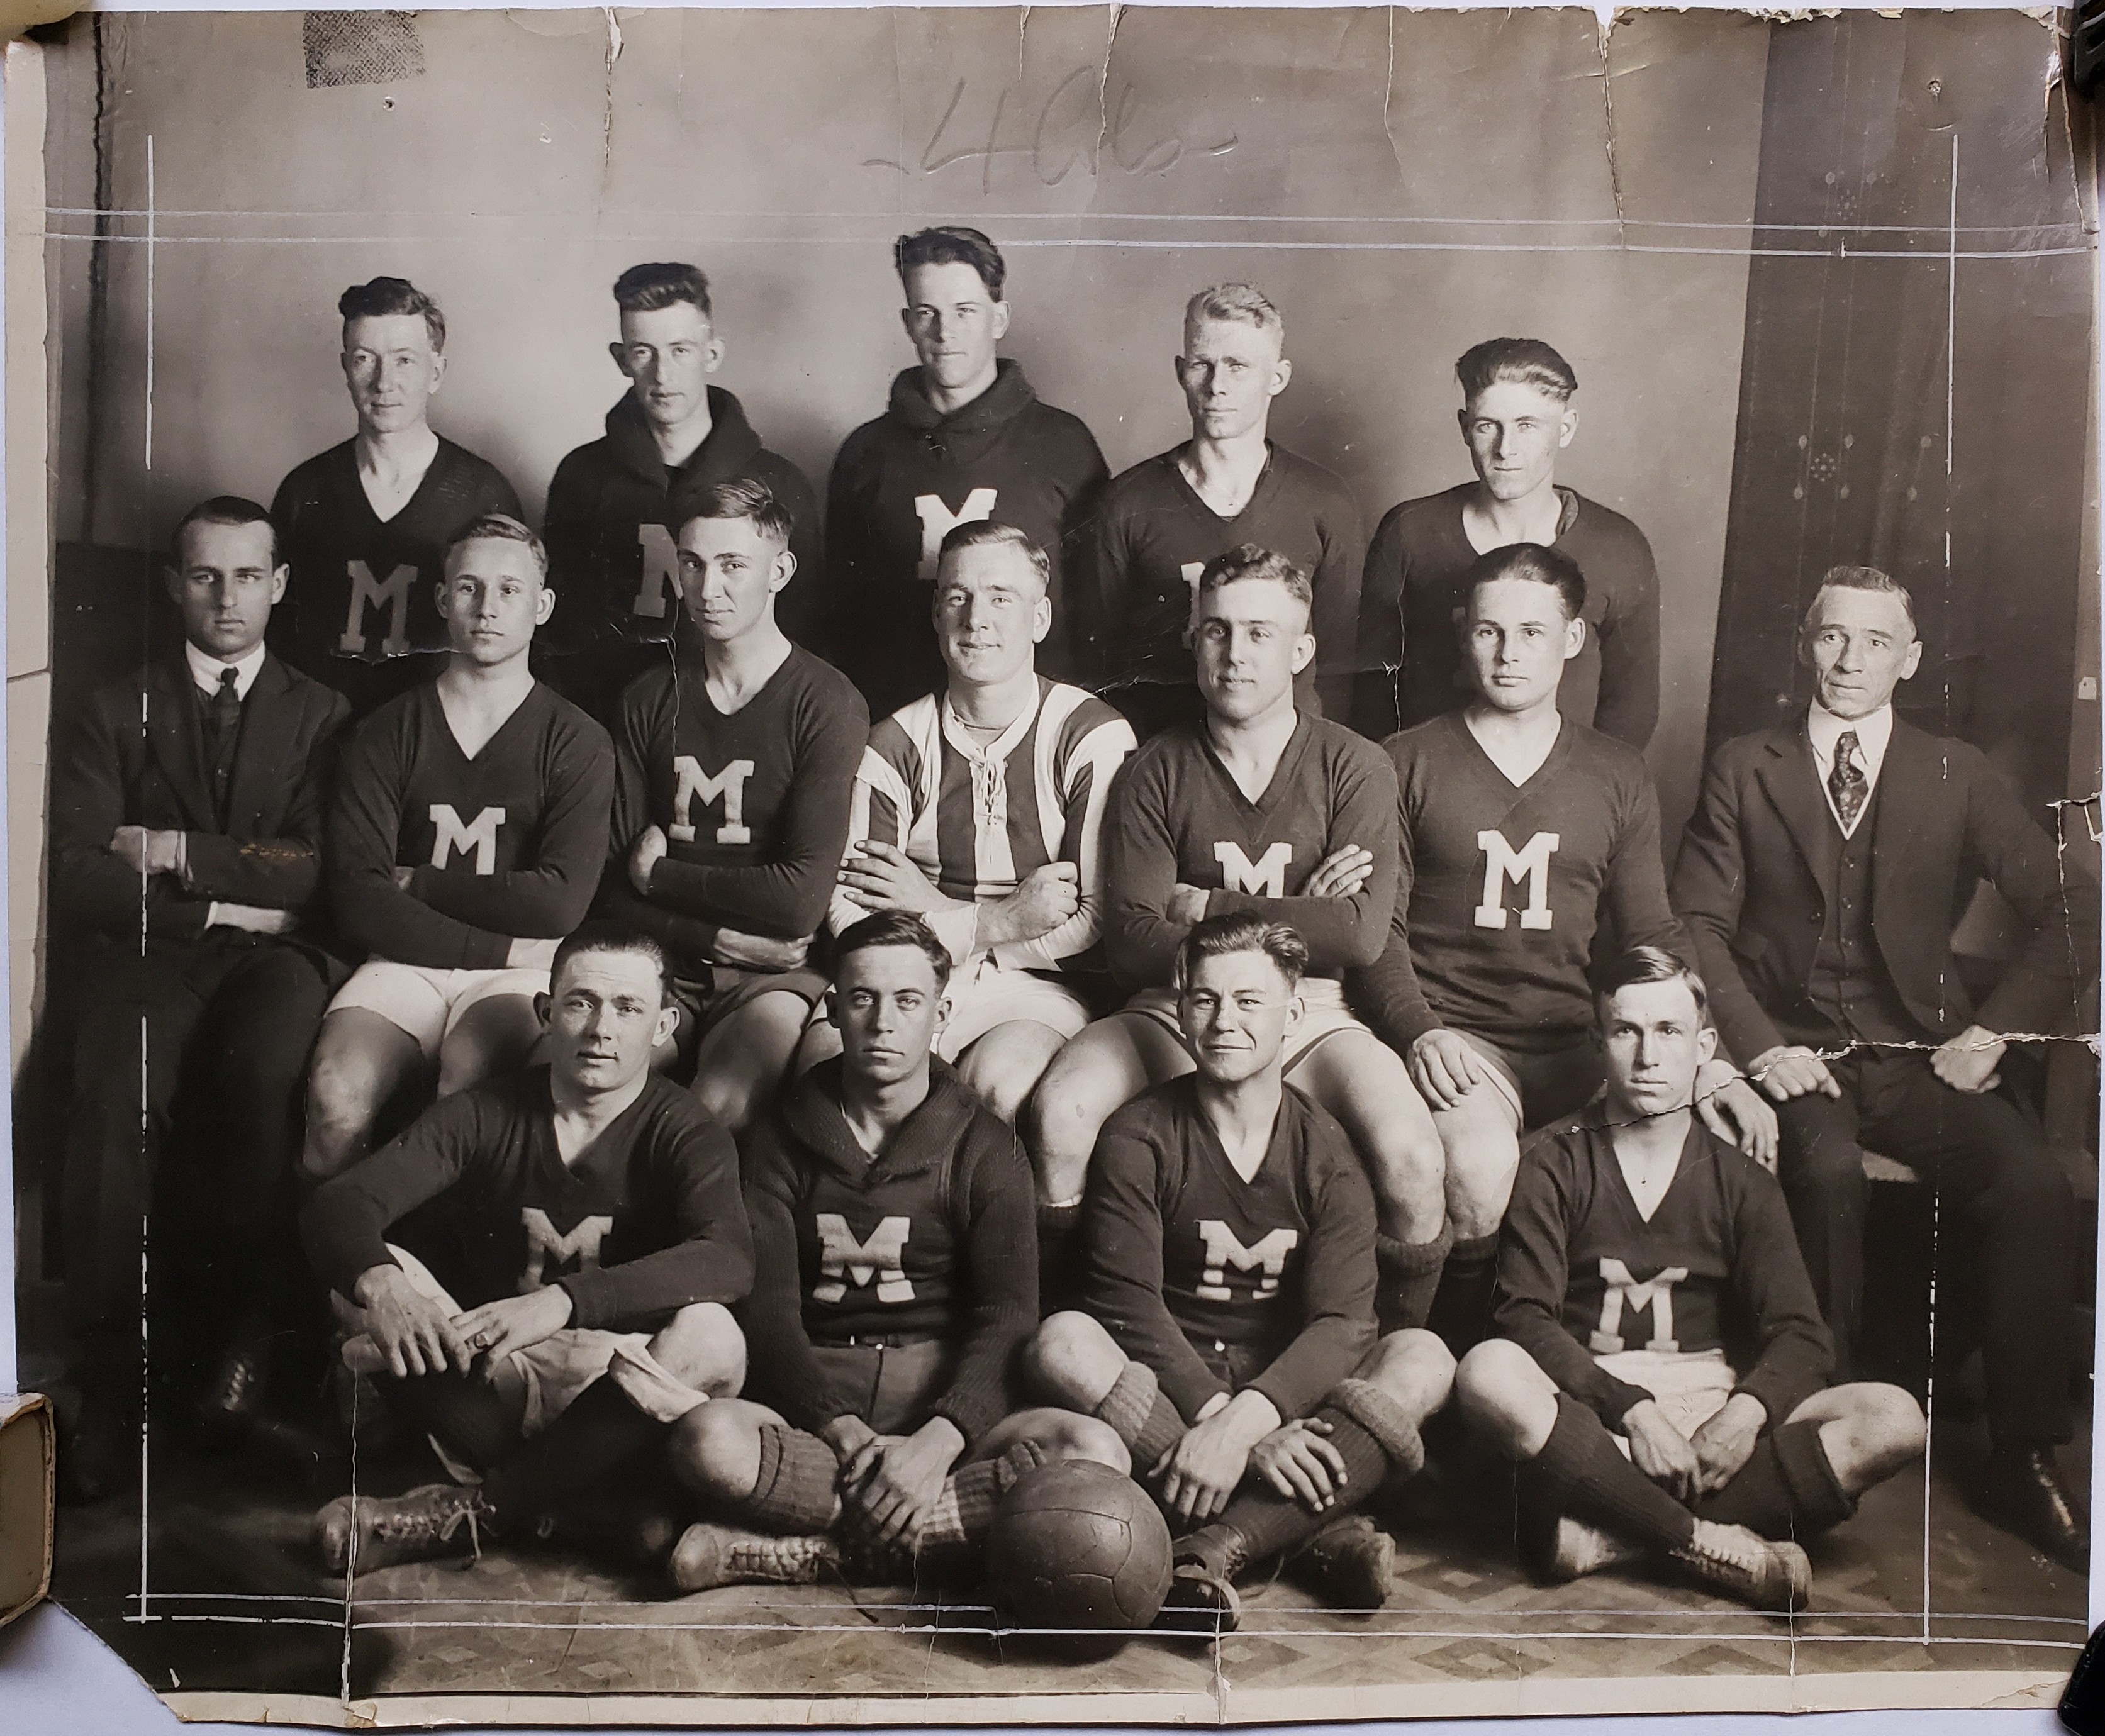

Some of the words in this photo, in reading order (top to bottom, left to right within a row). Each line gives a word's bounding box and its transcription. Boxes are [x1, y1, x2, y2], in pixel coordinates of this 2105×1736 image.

[340, 560, 418, 654] M
[429, 804, 506, 876] M
[669, 755, 755, 844] M
[1214, 841, 1292, 899] M
[1475, 830, 1560, 930] M
[518, 1206, 613, 1294] M
[812, 1213, 916, 1303] M
[1195, 1220, 1298, 1301] M
[1589, 1257, 1689, 1352] M
